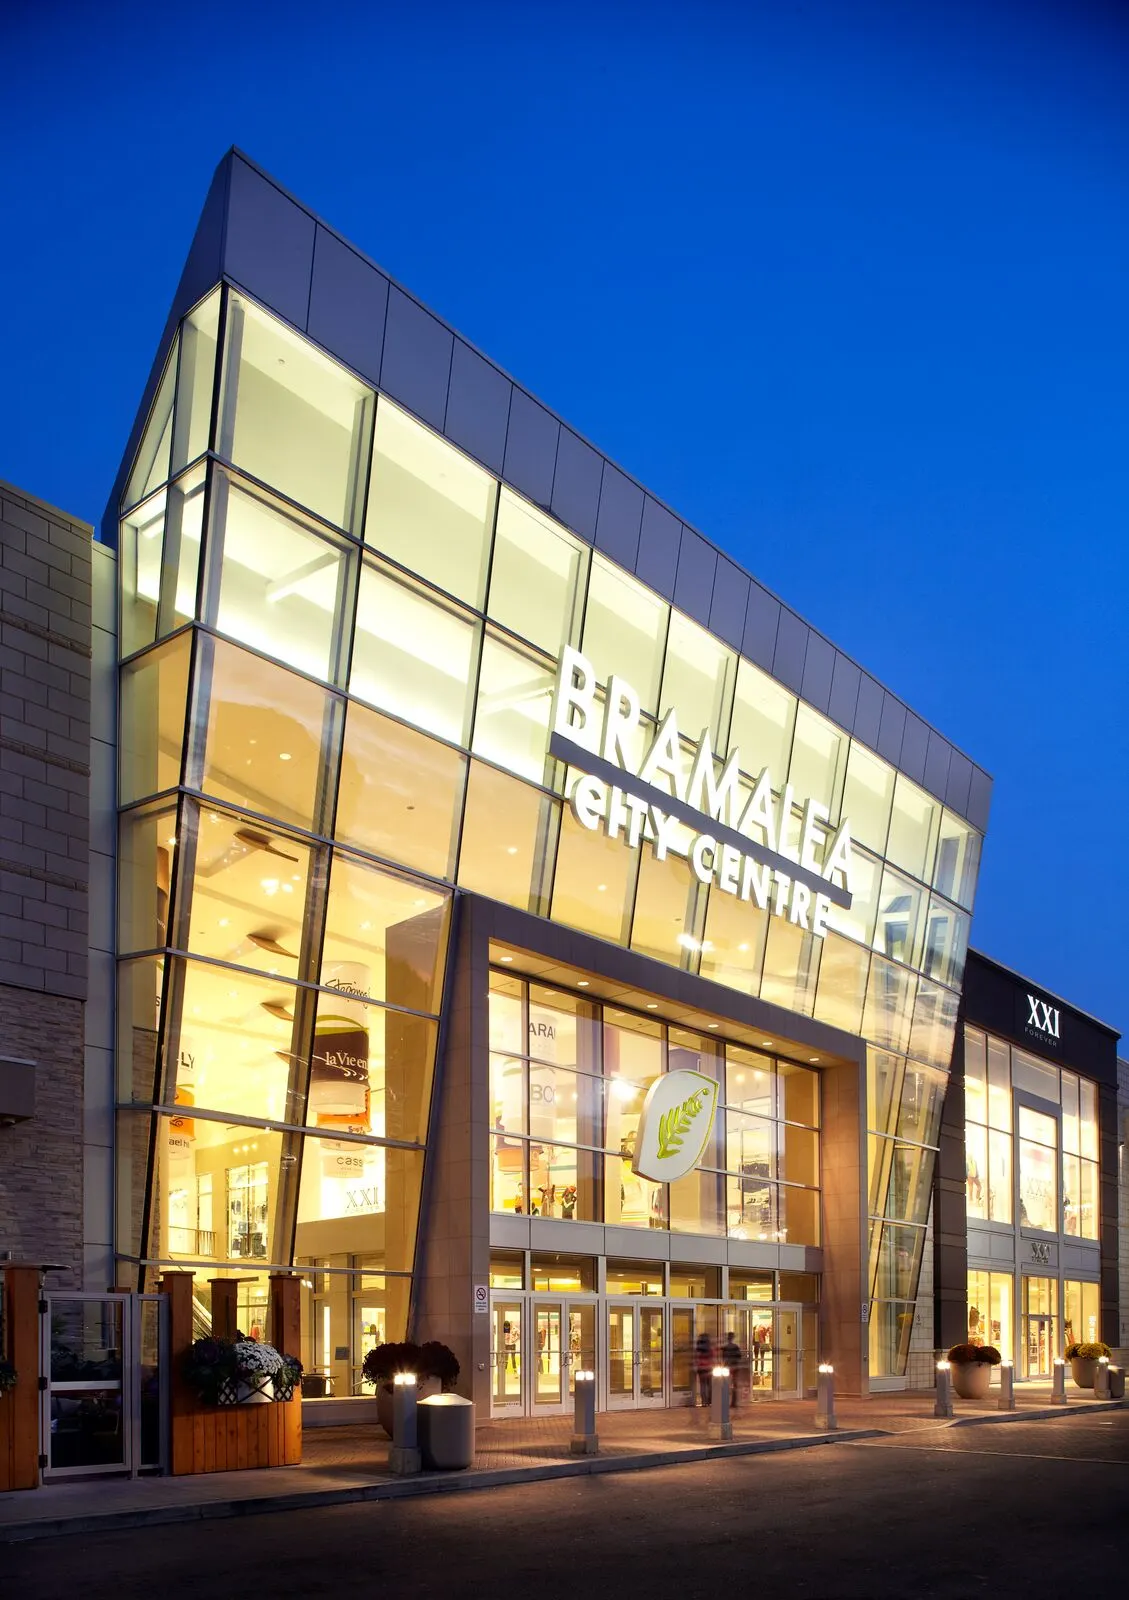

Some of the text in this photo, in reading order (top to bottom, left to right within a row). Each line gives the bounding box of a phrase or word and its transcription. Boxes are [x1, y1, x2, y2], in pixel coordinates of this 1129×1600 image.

[552, 643, 850, 895] BRAMALEA
[569, 775, 832, 938] CITY CENTRE
[1024, 1026, 1057, 1047] FOREVER
[1027, 994, 1060, 1039] XXI
